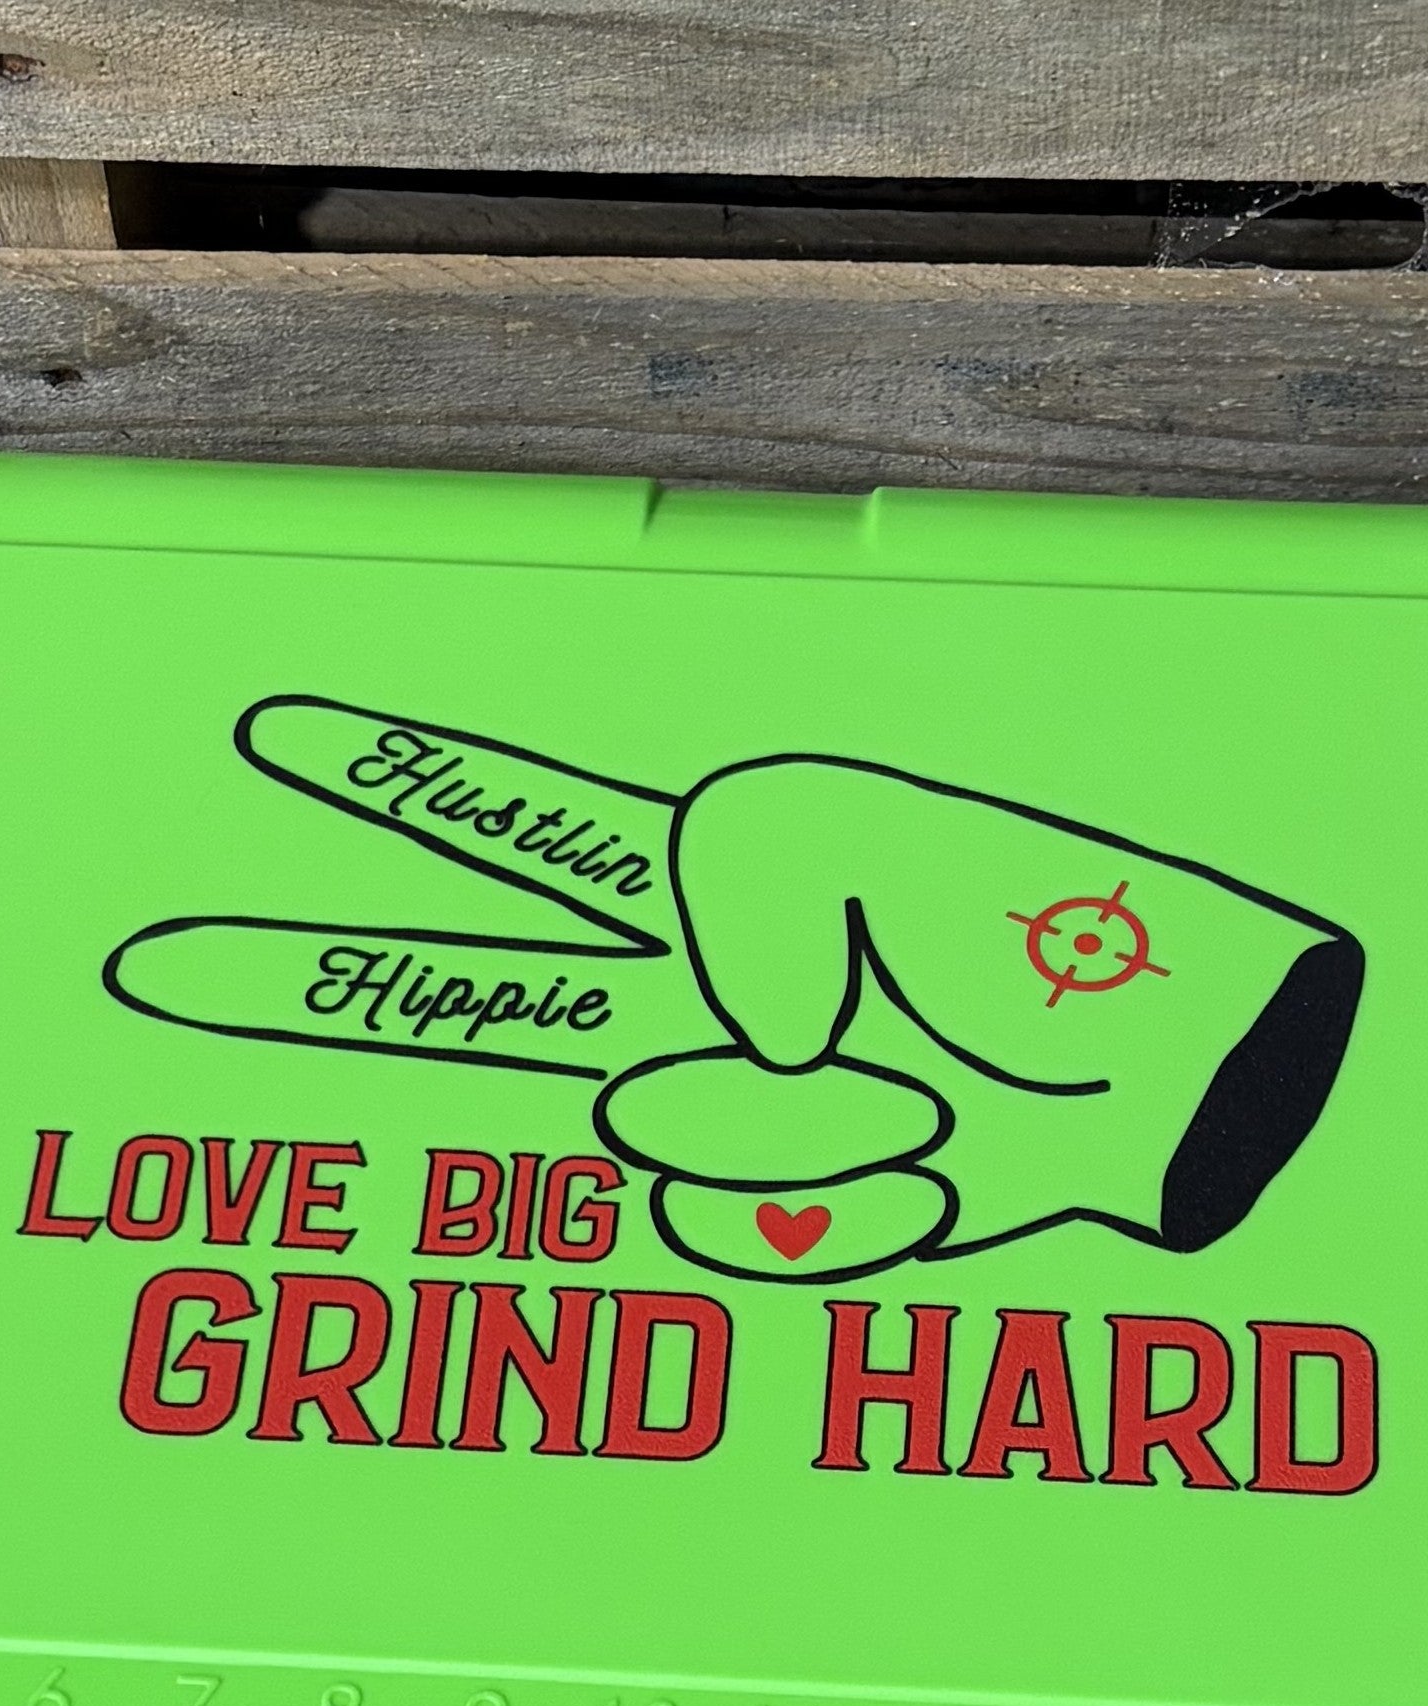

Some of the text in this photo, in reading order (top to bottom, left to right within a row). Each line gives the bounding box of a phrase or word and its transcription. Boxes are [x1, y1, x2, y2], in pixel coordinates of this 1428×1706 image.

[346, 729, 652, 897] Hustlin
[304, 946, 612, 1043] Hippie
[16, 1130, 628, 1264] LOVE BIG
[119, 1268, 1380, 1497] GRIND HARD
